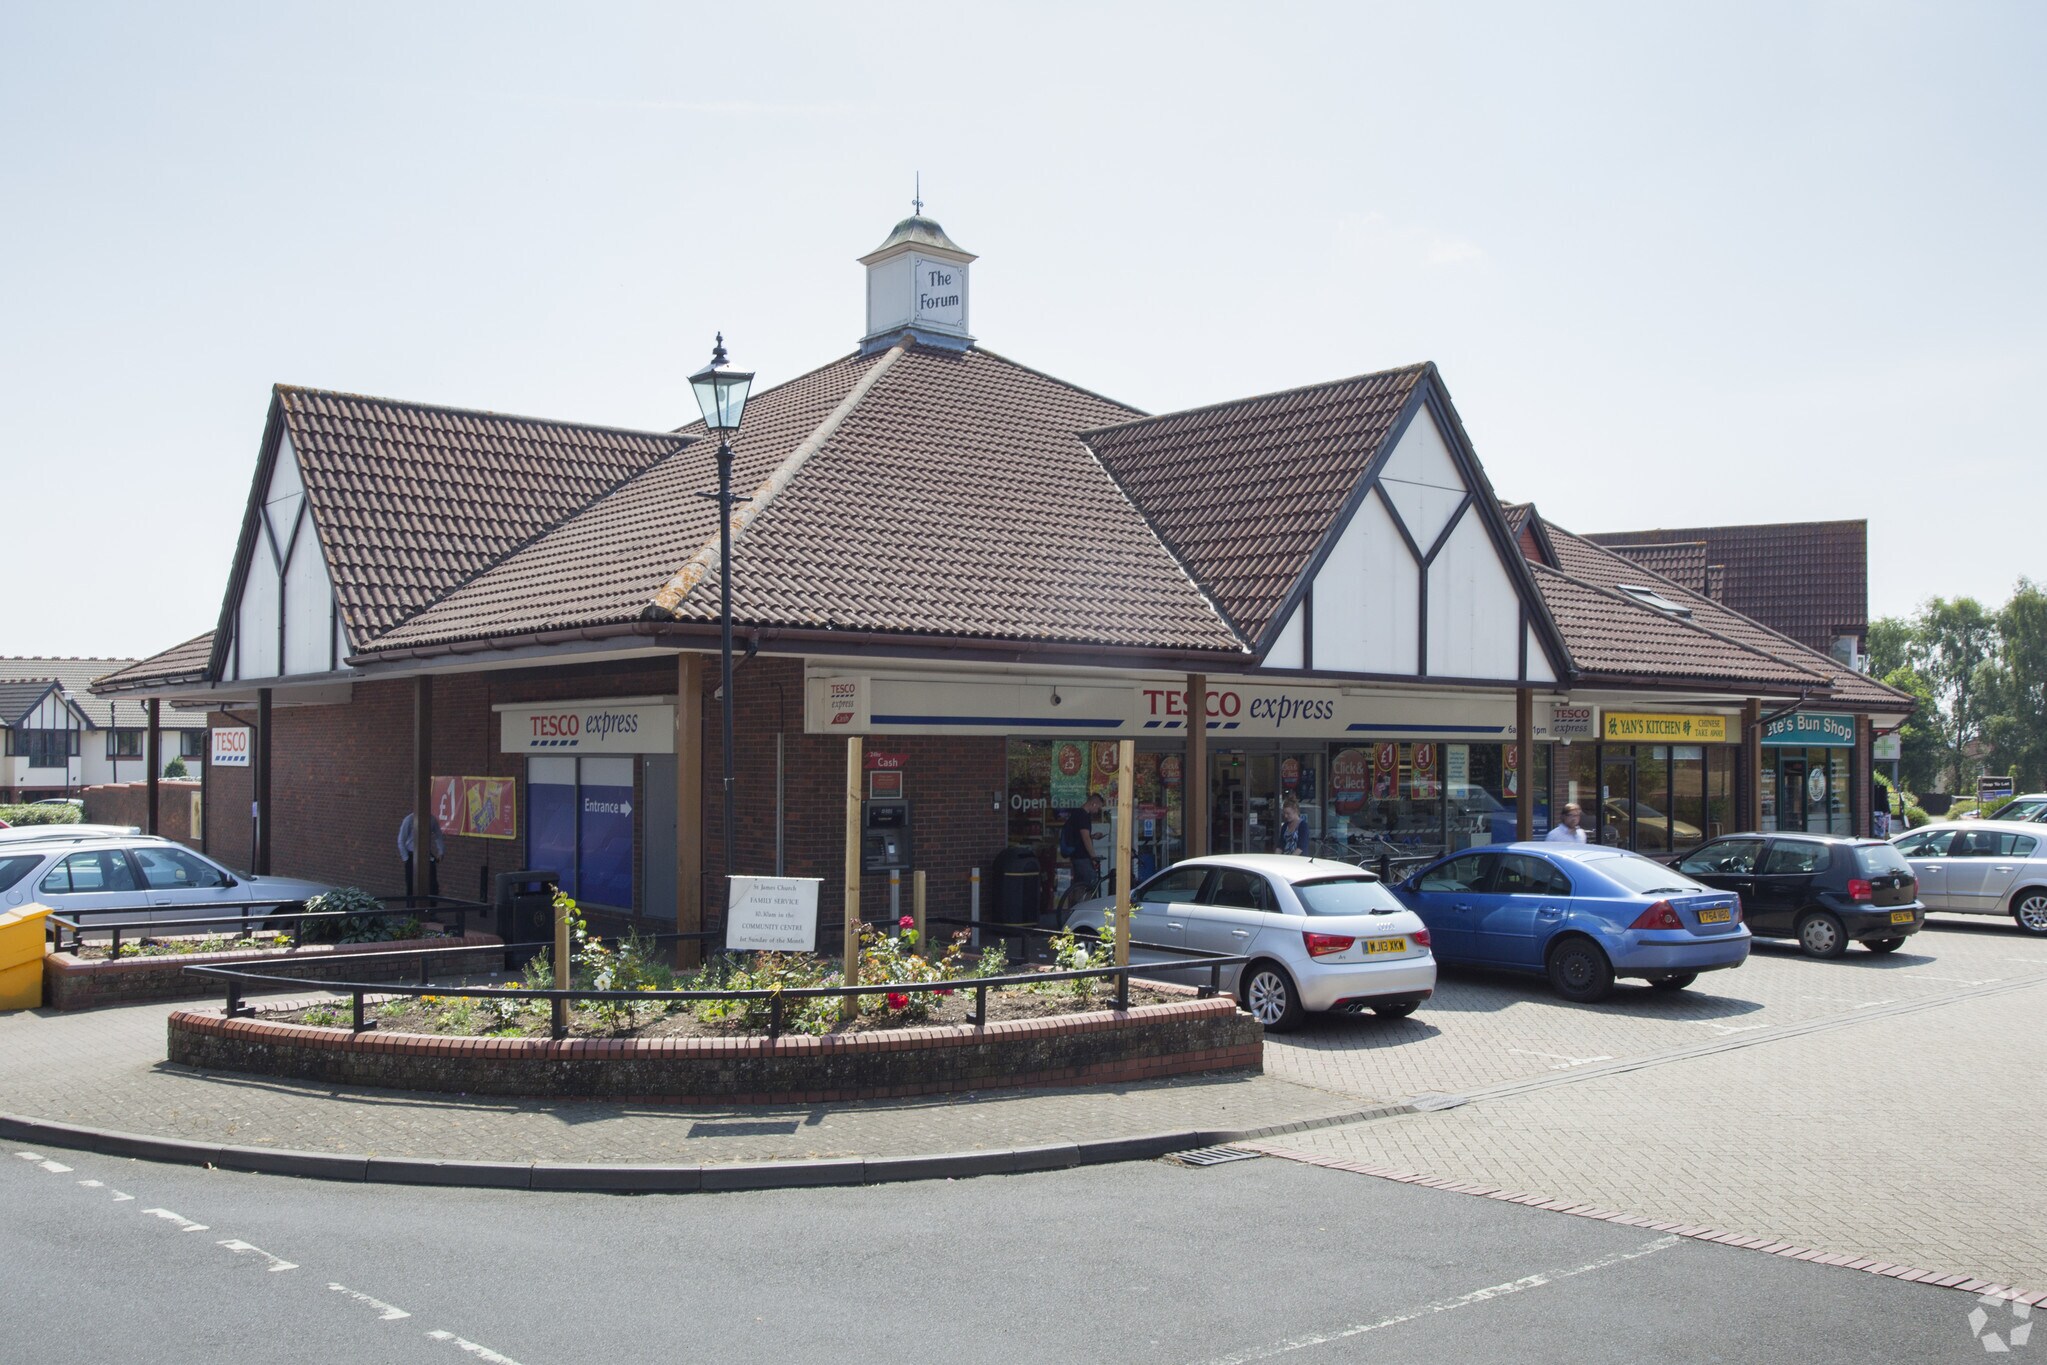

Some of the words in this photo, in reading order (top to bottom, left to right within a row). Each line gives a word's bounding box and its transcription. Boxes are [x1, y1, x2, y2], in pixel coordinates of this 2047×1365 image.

[928, 270, 952, 287] The
[920, 294, 959, 310] Forum
[831, 684, 855, 693] TESCO
[832, 700, 854, 710] express
[1250, 695, 1334, 728] express
[1554, 709, 1590, 718] TESCO
[530, 714, 580, 736] TESCO
[585, 711, 638, 742] express
[1508, 725, 1517, 734] 6a
[1532, 725, 1547, 735] 1pm
[1554, 724, 1588, 733] express
[1620, 719, 1643, 734] YAN'S
[1646, 720, 1681, 735] KITCHEN
[1695, 729, 1708, 737] TAKE
[1767, 717, 1794, 736] ete's
[1797, 716, 1820, 730] Bun
[1823, 718, 1852, 741] Shop
[215, 732, 246, 752] TESCO
[1101, 743, 1118, 765] £1
[1380, 744, 1393, 763] £1
[1417, 744, 1430, 763] £1
[877, 757, 898, 767] Cash
[1333, 761, 1355, 774] Click
[1356, 764, 1364, 775] &
[439, 778, 456, 821] £1
[585, 798, 619, 814] Entrance
[1011, 794, 1047, 813] Open
[1369, 941, 1388, 953] WJ13
[1389, 939, 1404, 950] XKW
